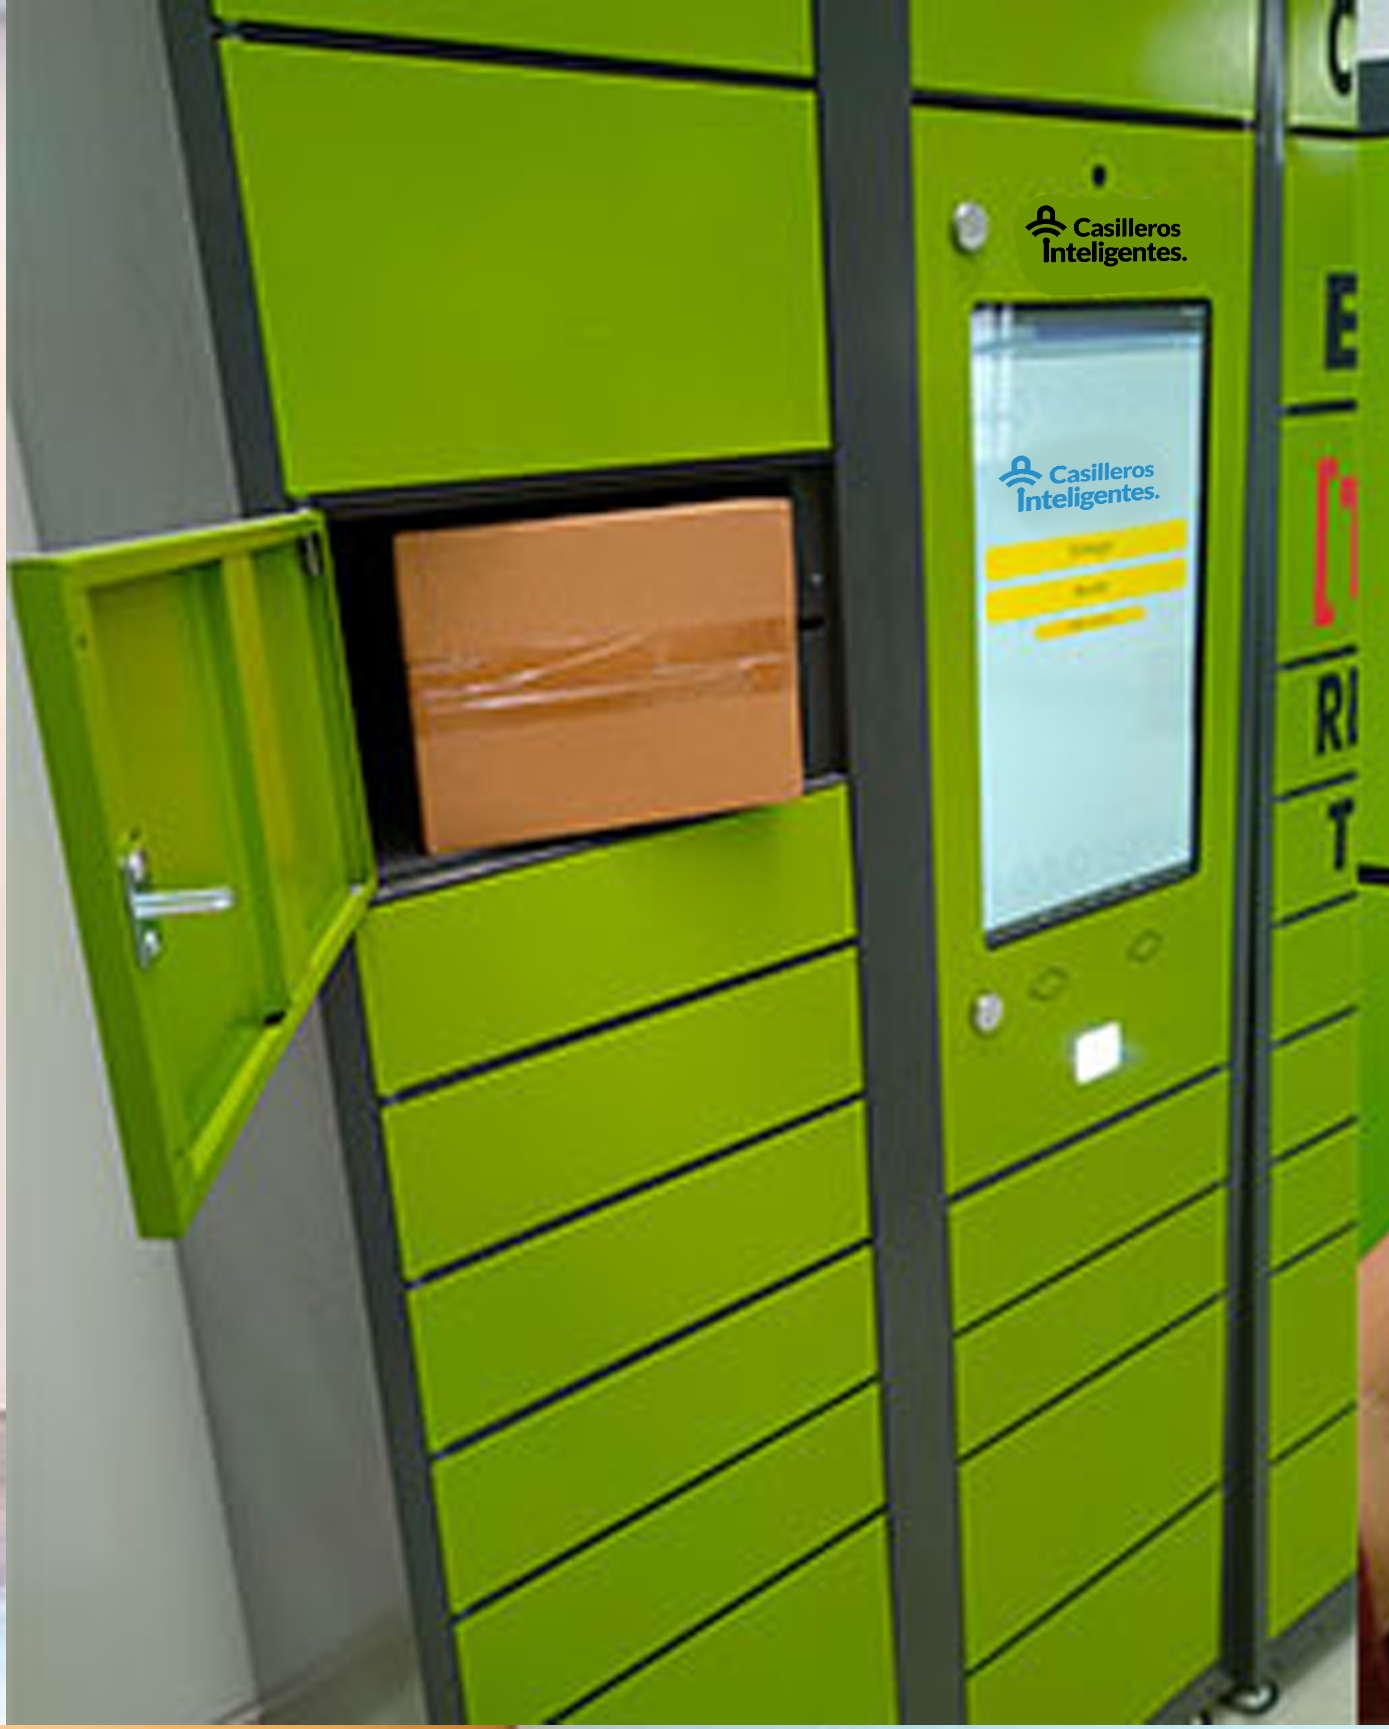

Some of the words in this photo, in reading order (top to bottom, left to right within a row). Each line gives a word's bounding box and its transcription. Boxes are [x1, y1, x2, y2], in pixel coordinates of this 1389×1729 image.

[1073, 217, 1182, 239] Casilleros
[1042, 237, 1188, 267] Inteligentes.
[1049, 462, 1155, 485] Casilleros
[1016, 484, 1160, 513] Inteligentes.
